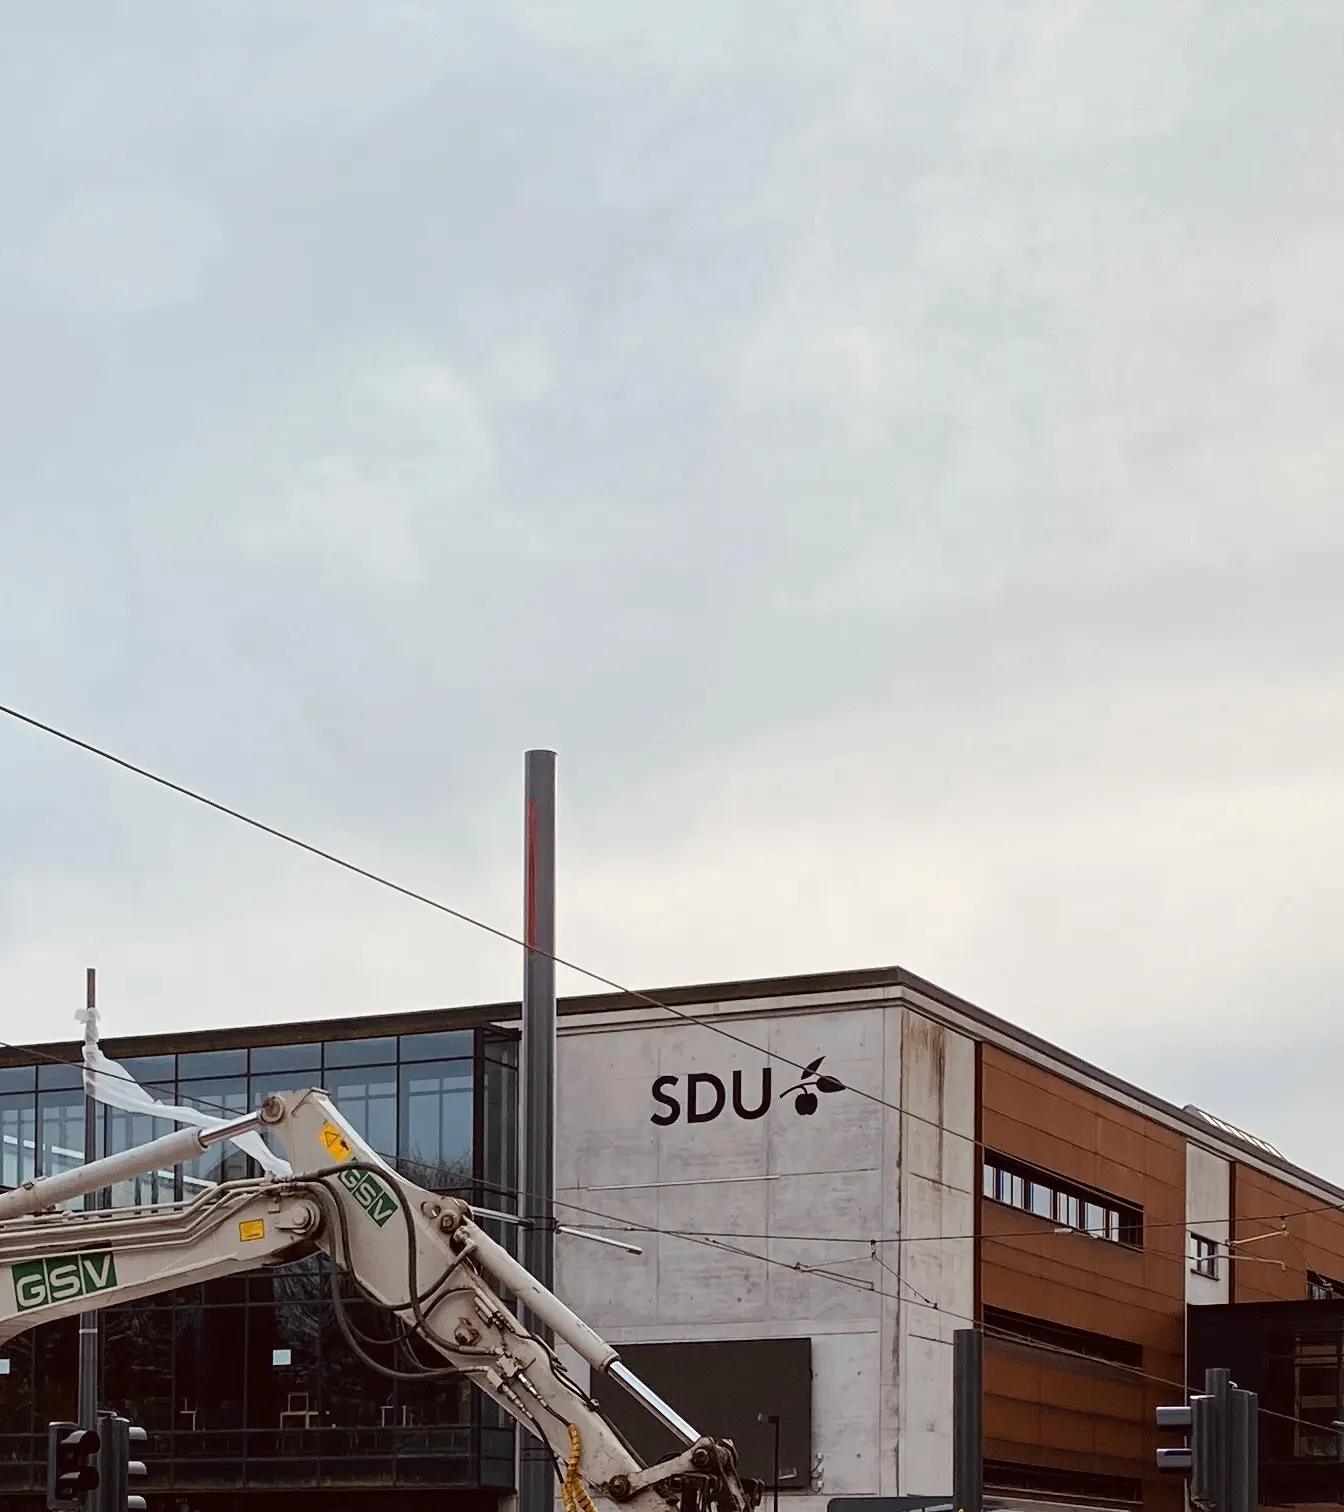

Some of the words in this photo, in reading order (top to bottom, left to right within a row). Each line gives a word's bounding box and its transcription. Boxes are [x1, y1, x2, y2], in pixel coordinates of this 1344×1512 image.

[650, 1067, 772, 1126] SDU
[340, 1169, 393, 1221] GSV
[16, 1254, 112, 1307] GSV
